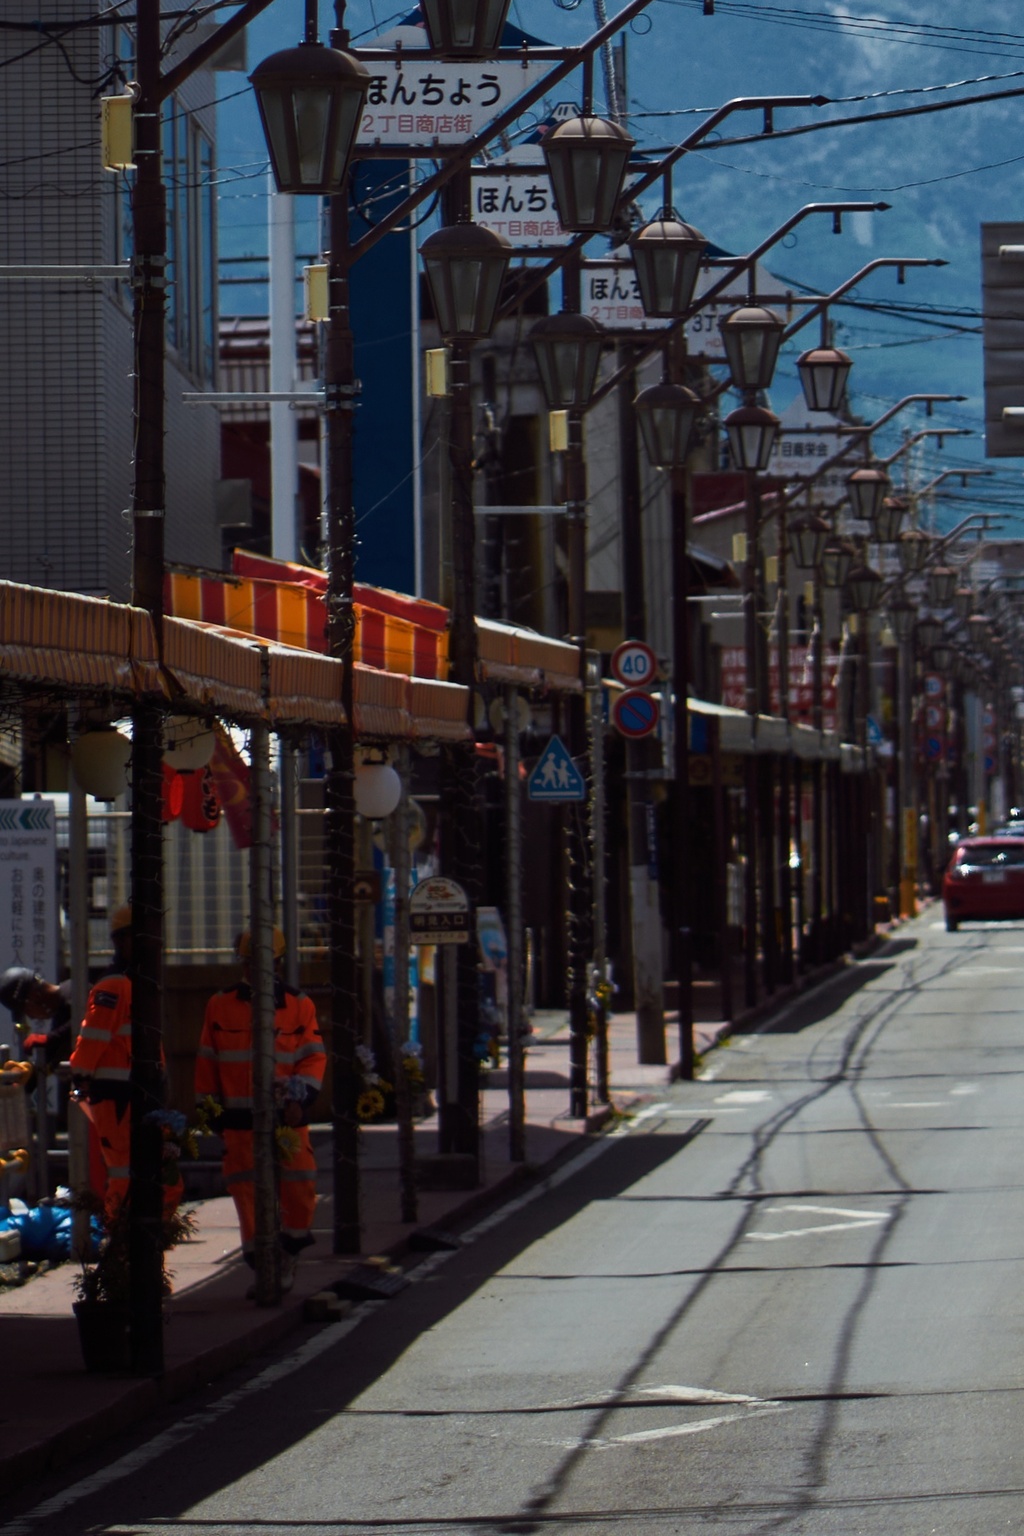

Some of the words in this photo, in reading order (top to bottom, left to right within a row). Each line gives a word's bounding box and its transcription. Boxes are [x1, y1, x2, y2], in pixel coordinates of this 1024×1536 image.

[365, 73, 500, 106] ほんちょう
[361, 114, 473, 133] 2丁目商店街
[478, 186, 557, 213] ほんち
[623, 654, 647, 674] 40
